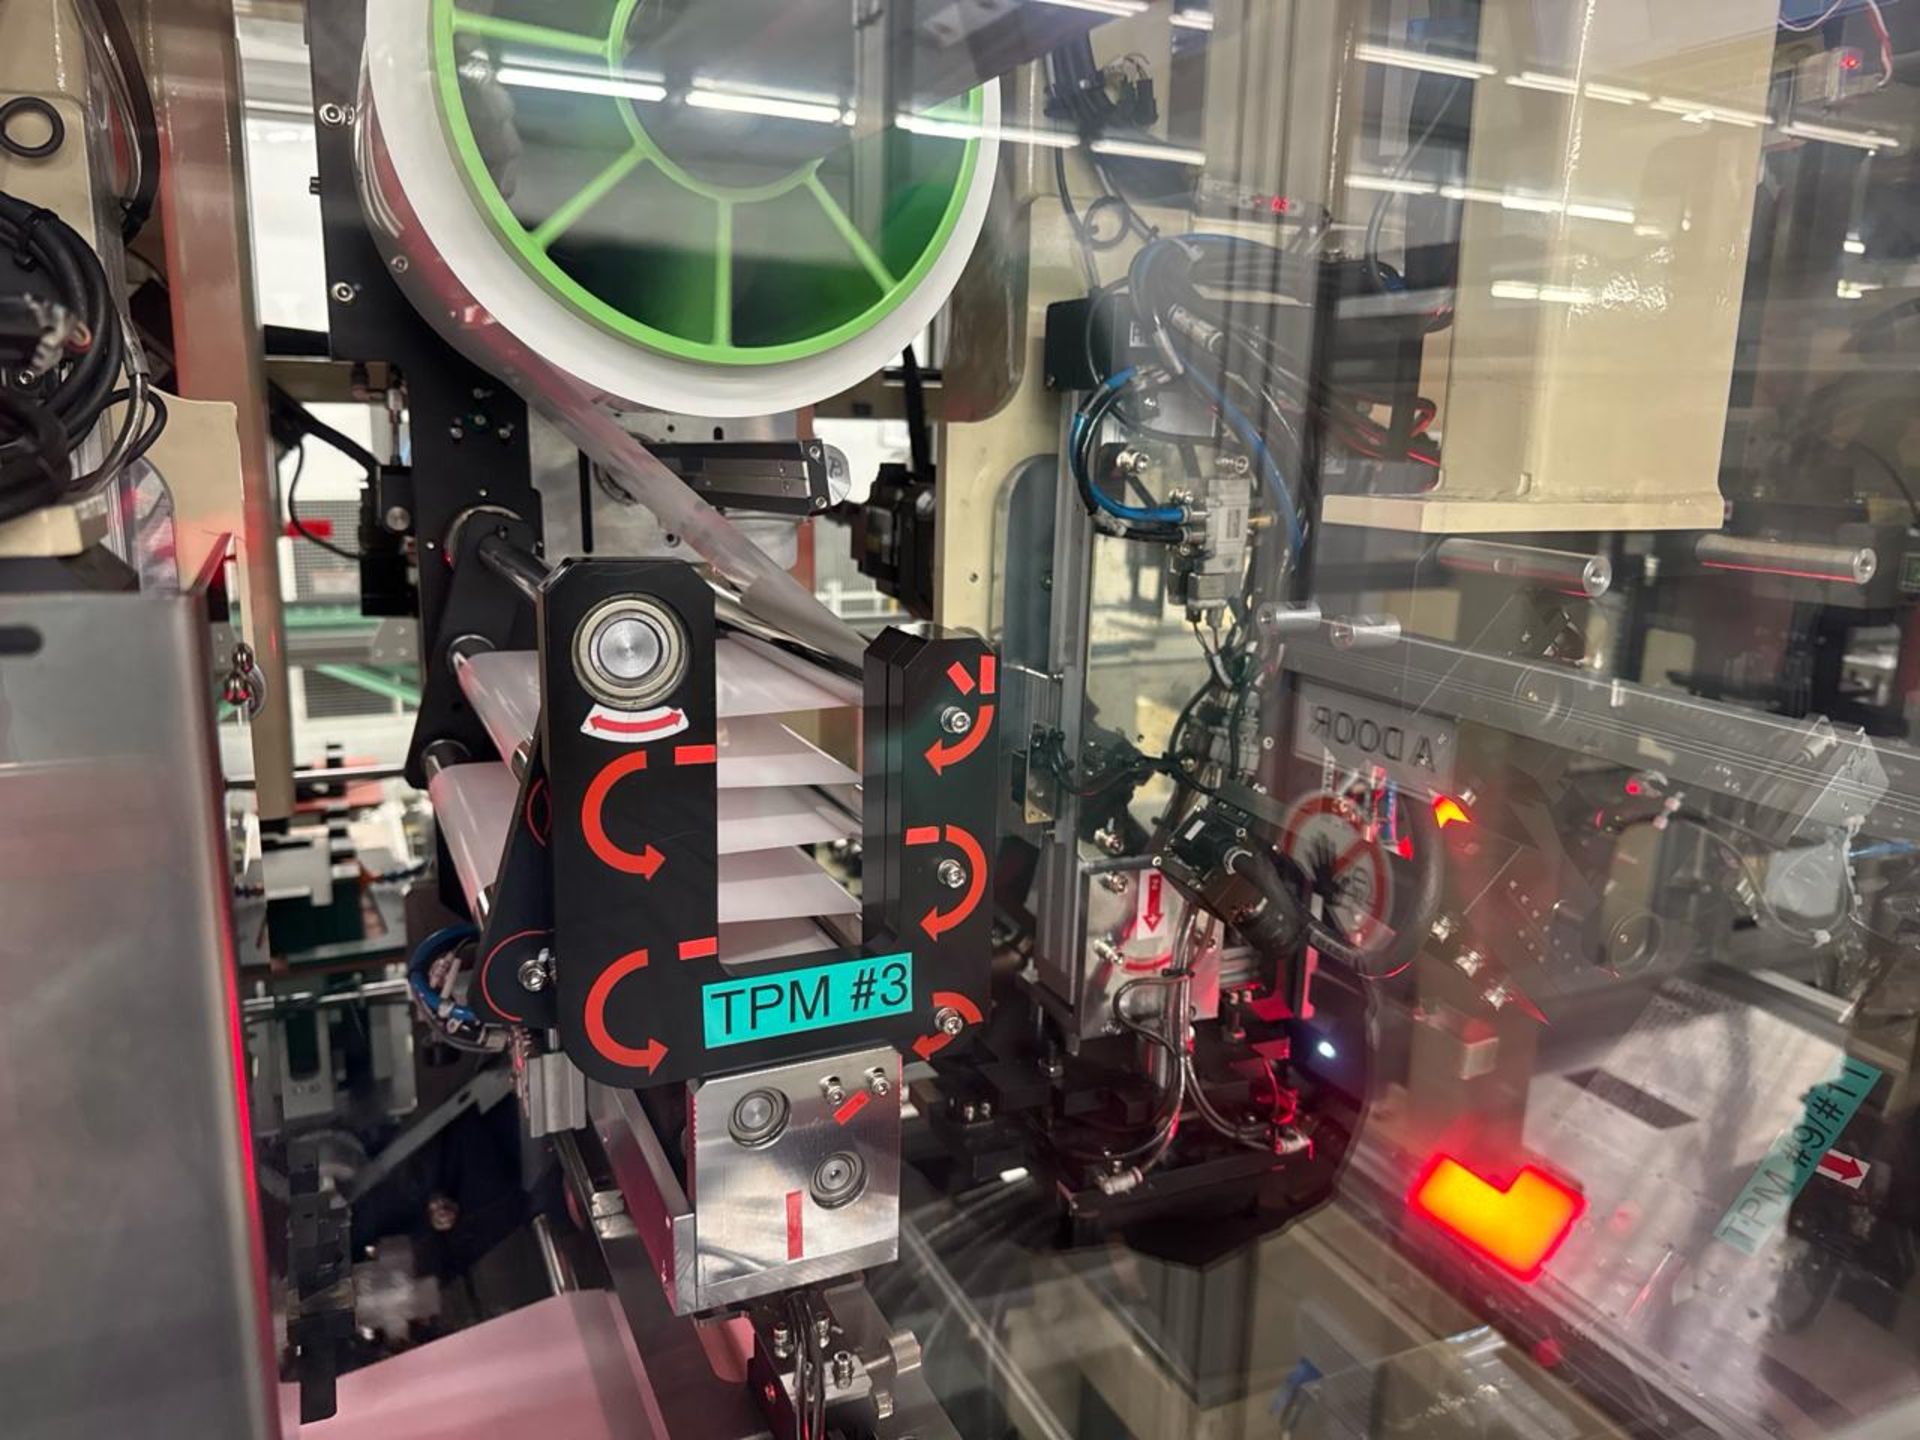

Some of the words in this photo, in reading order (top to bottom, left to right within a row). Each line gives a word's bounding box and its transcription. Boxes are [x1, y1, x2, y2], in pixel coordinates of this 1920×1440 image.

[710, 974, 830, 1035] TPM
[850, 962, 909, 1012] #3
[1719, 1168, 1797, 1243] TPM
[1780, 1064, 1870, 1169] #9/#11
